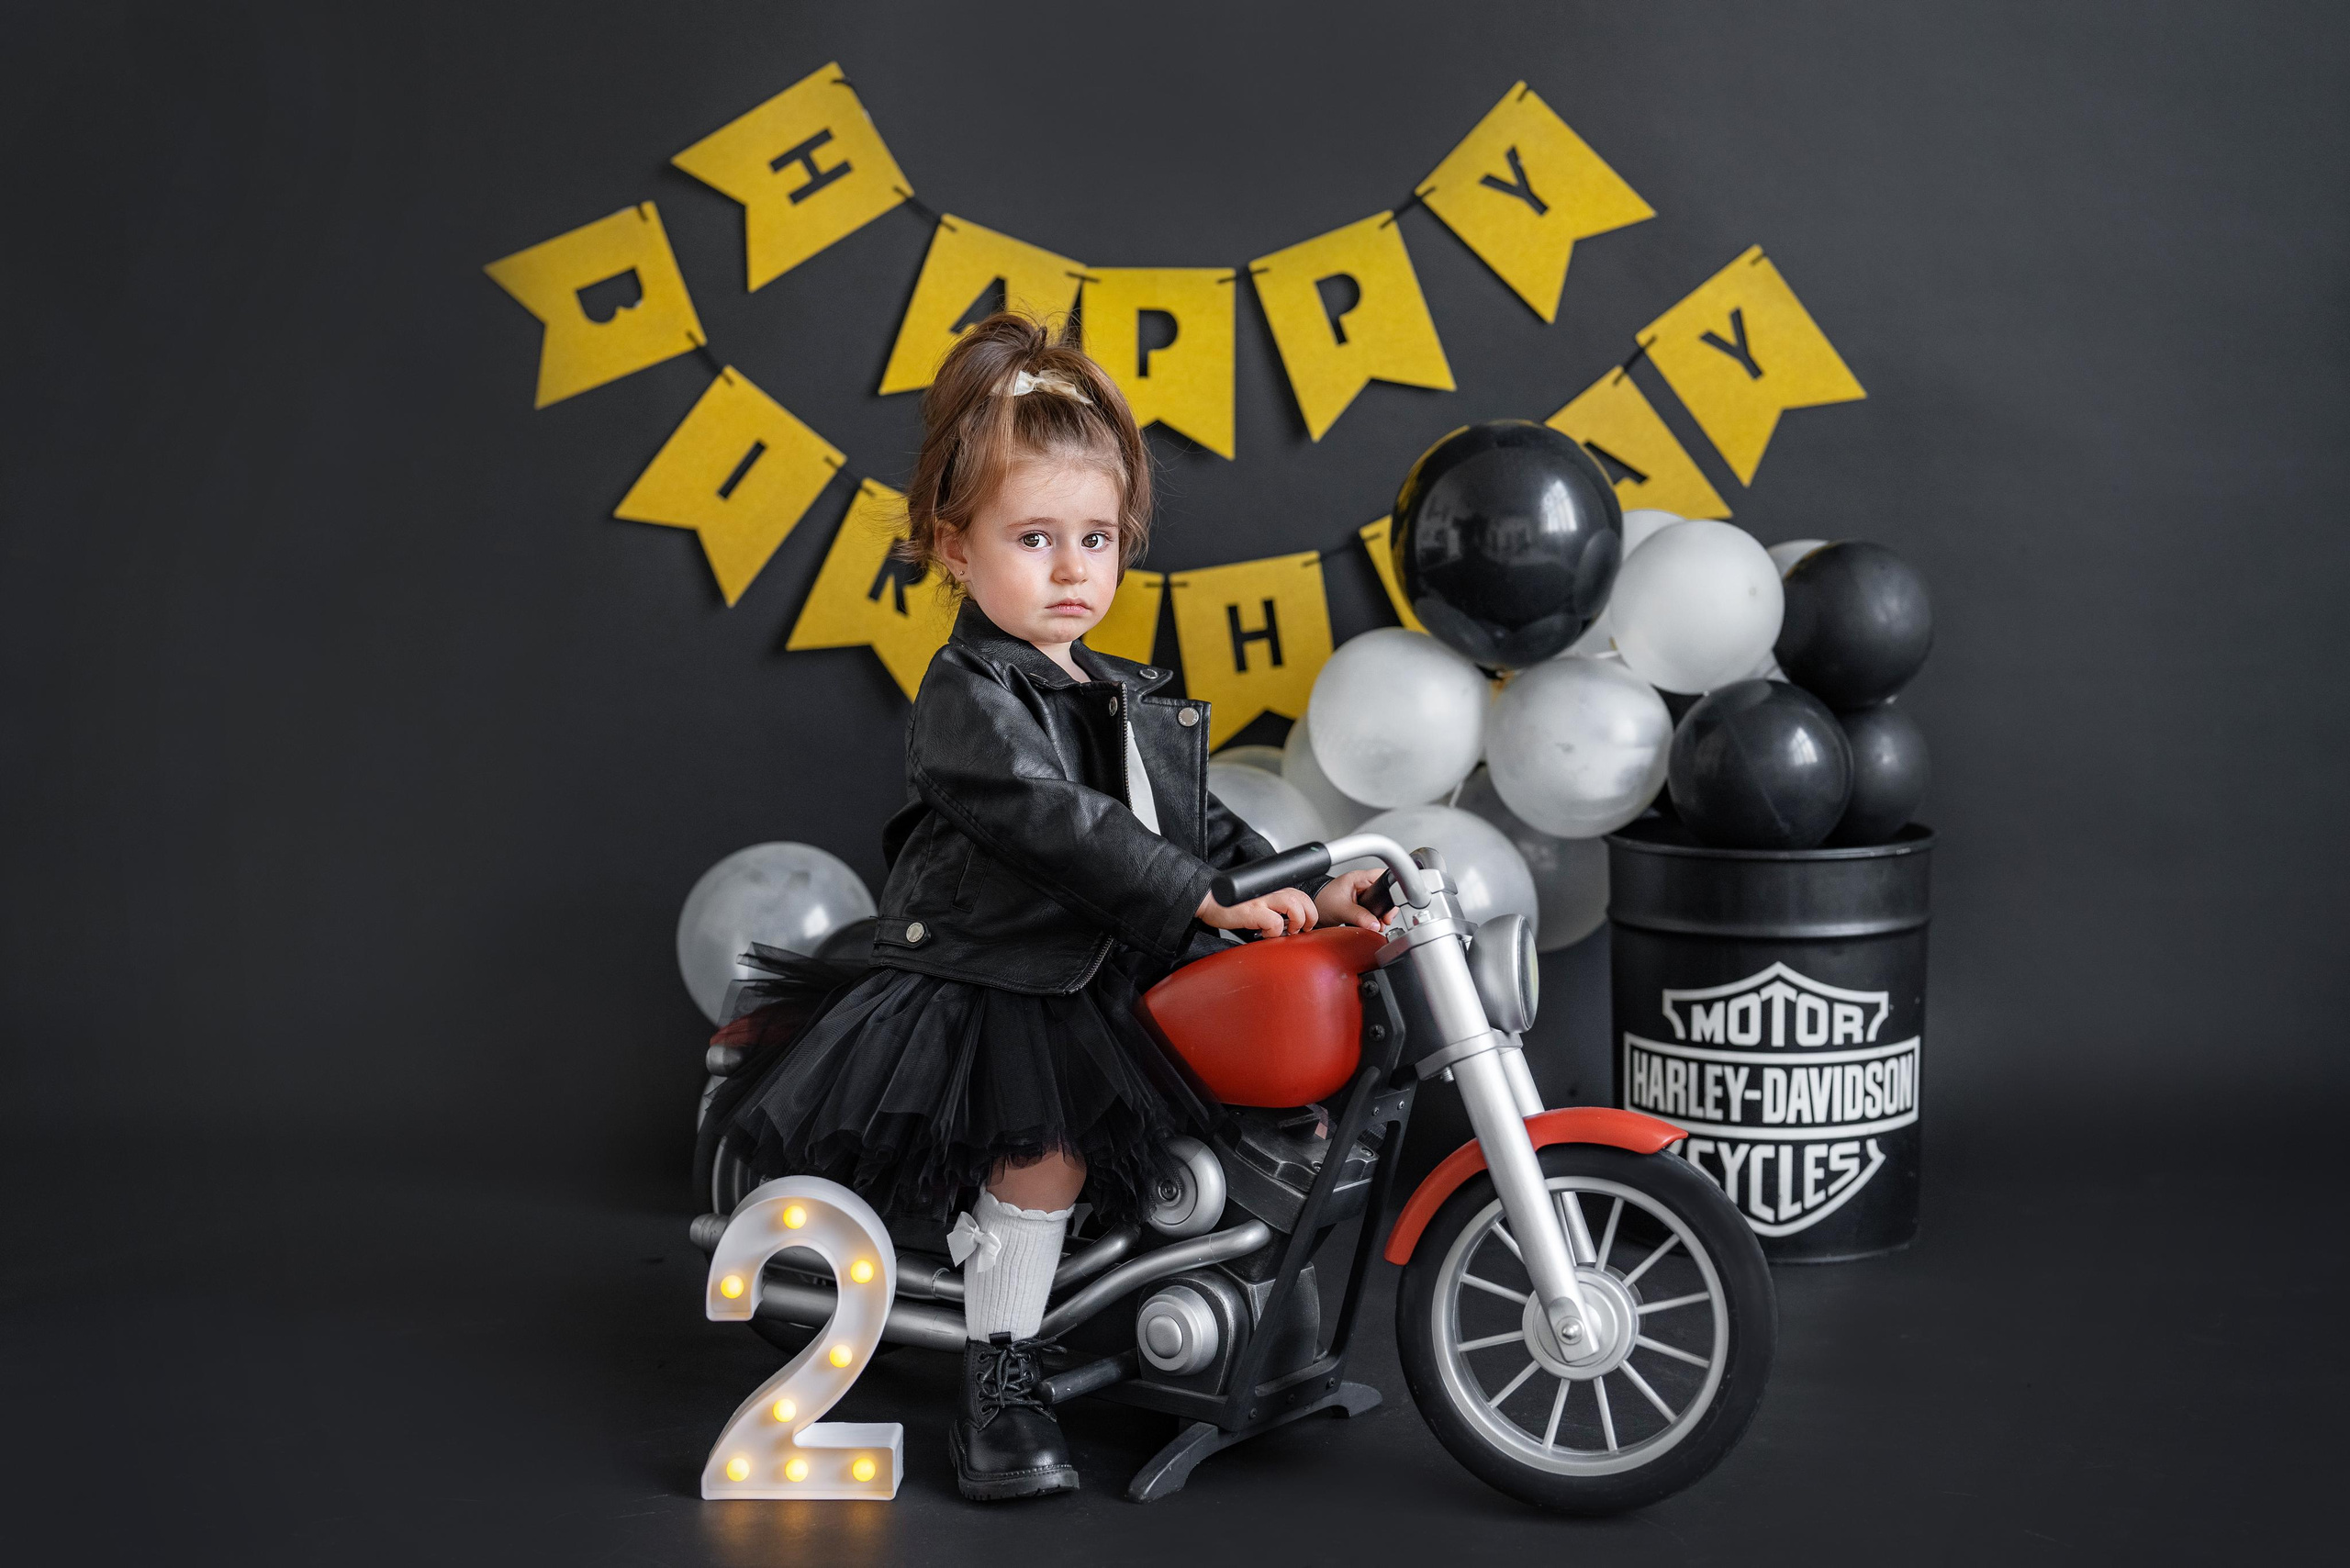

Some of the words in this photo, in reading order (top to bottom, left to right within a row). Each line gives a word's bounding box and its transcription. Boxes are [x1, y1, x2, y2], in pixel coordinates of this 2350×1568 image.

[576, 267, 1763, 674] BIRHAY
[1690, 980, 1863, 1047] MOTOR
[1632, 1049, 1914, 1124] HARLEY-DAVIDSON
[1687, 1138, 1860, 1223] CYCLES
[700, 1175, 903, 1501] 2
